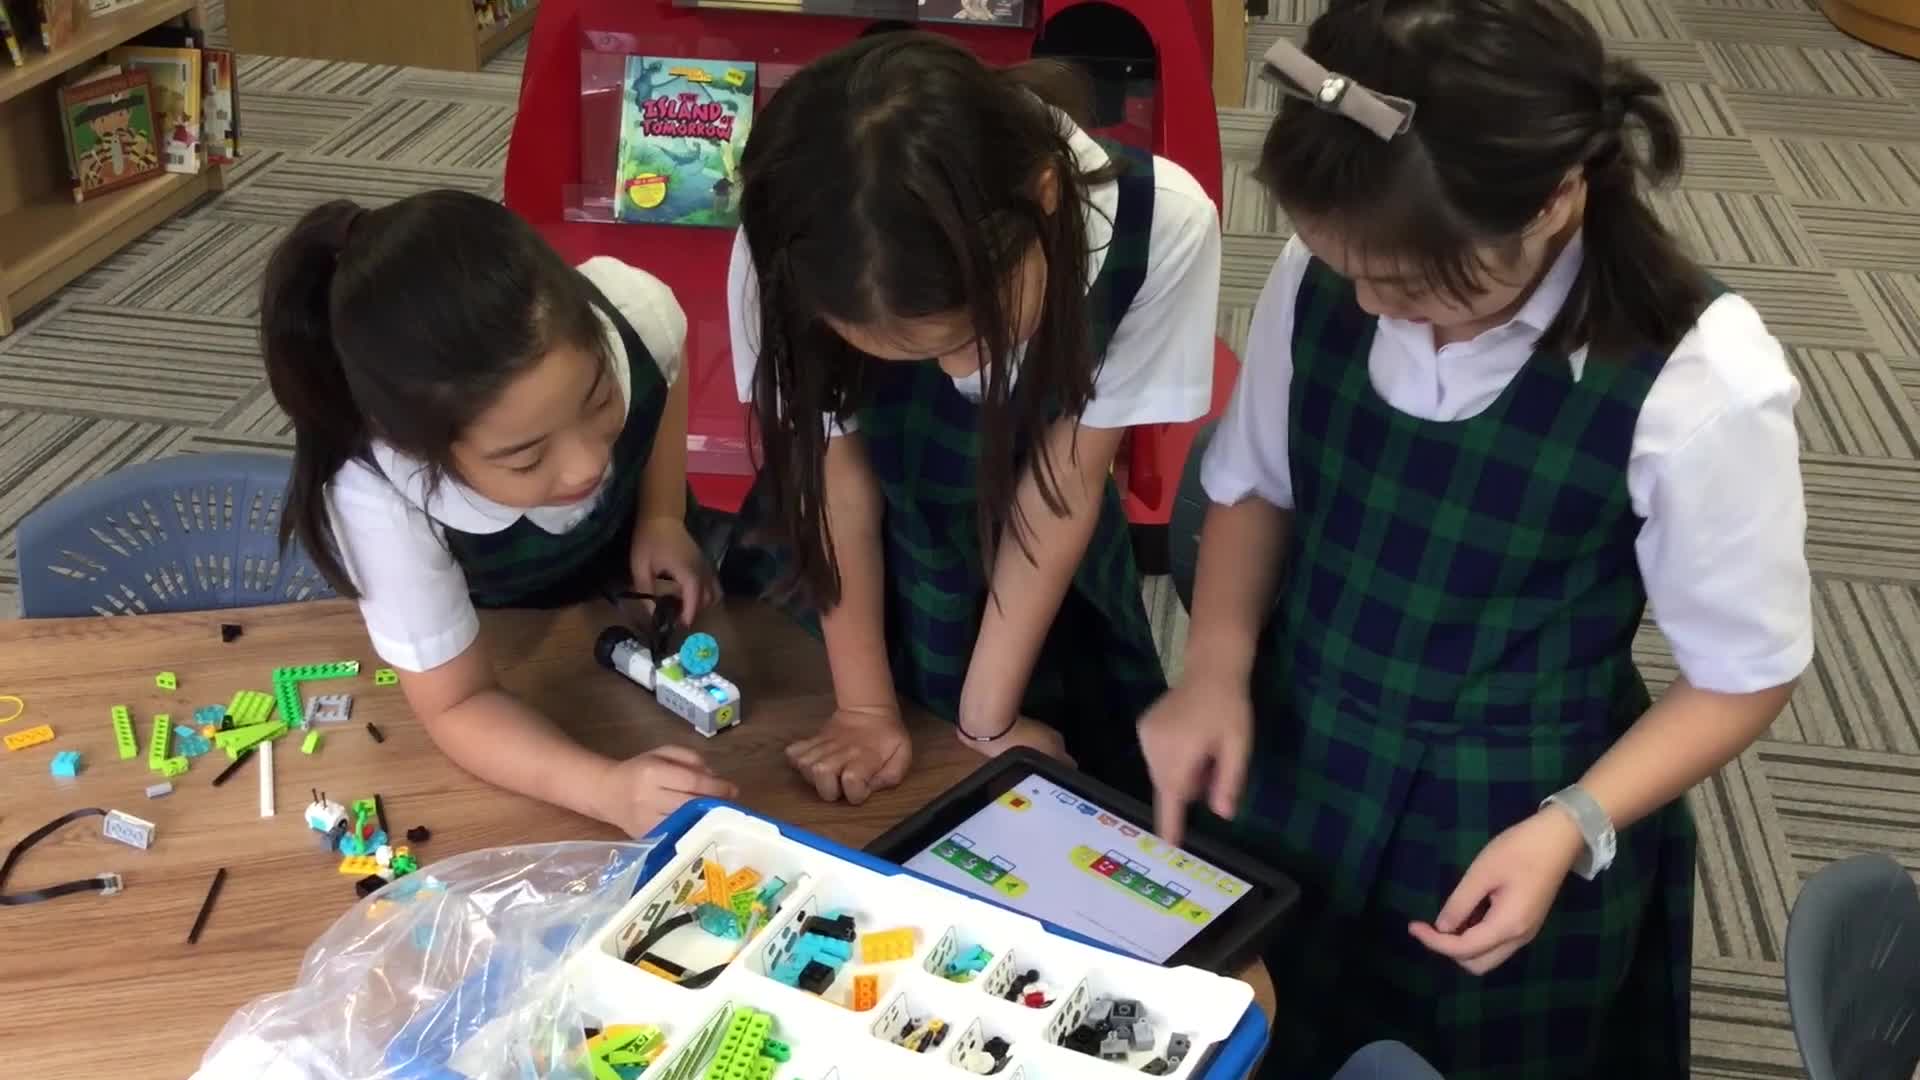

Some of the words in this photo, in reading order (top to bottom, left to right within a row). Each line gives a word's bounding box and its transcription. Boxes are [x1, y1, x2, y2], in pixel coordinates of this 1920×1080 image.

[678, 93, 700, 103] THE
[642, 95, 722, 123] ISLAND
[721, 115, 735, 128] OF
[640, 119, 734, 142] TOMORROW
